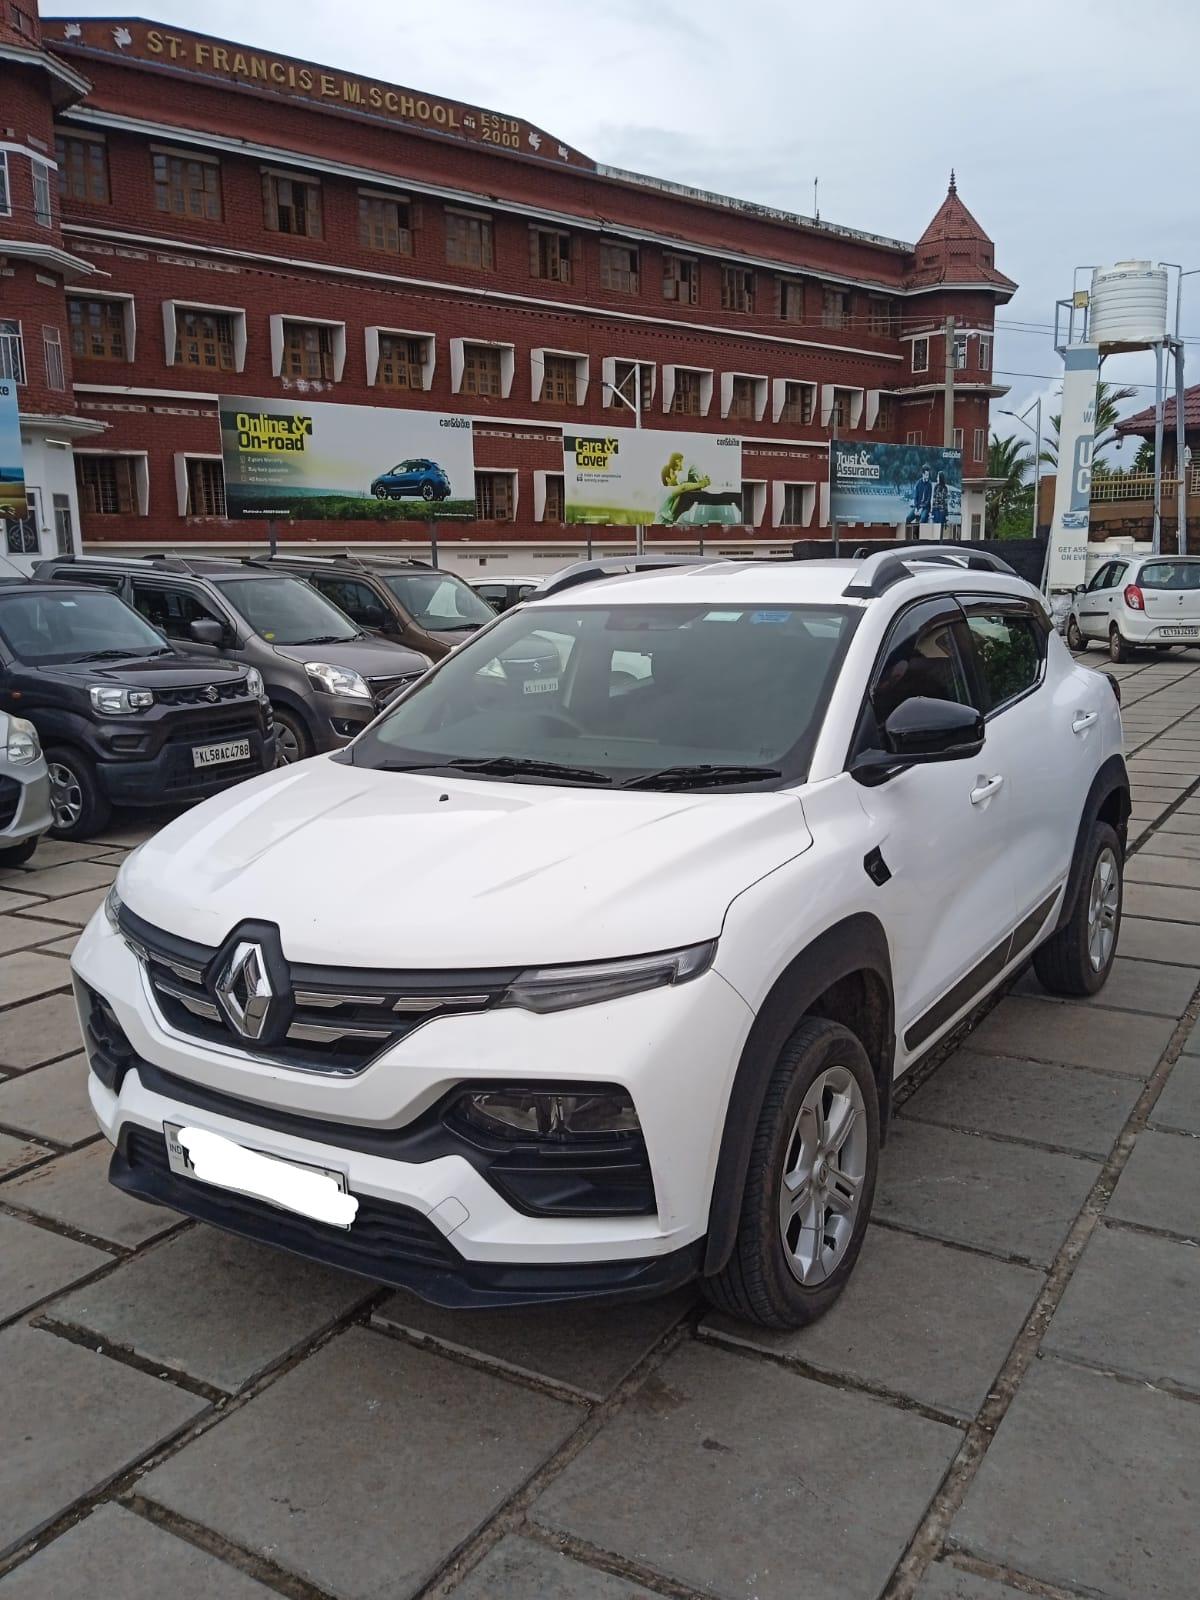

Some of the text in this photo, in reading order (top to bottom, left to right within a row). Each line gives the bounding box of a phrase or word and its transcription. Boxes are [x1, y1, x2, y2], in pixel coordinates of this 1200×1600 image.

[147, 31, 187, 58] ST.
[195, 42, 313, 90] FRANCIS
[480, 112, 519, 133] ESTD
[481, 128, 520, 148] 2000
[236, 413, 312, 436] Online &
[238, 430, 304, 451] On-road
[575, 437, 618, 454] Care &
[575, 452, 608, 467] Cover
[836, 450, 871, 466] Trust &
[837, 463, 879, 477] Assurance
[199, 744, 249, 763] KL58AC4788
[169, 1143, 182, 1154] IND
